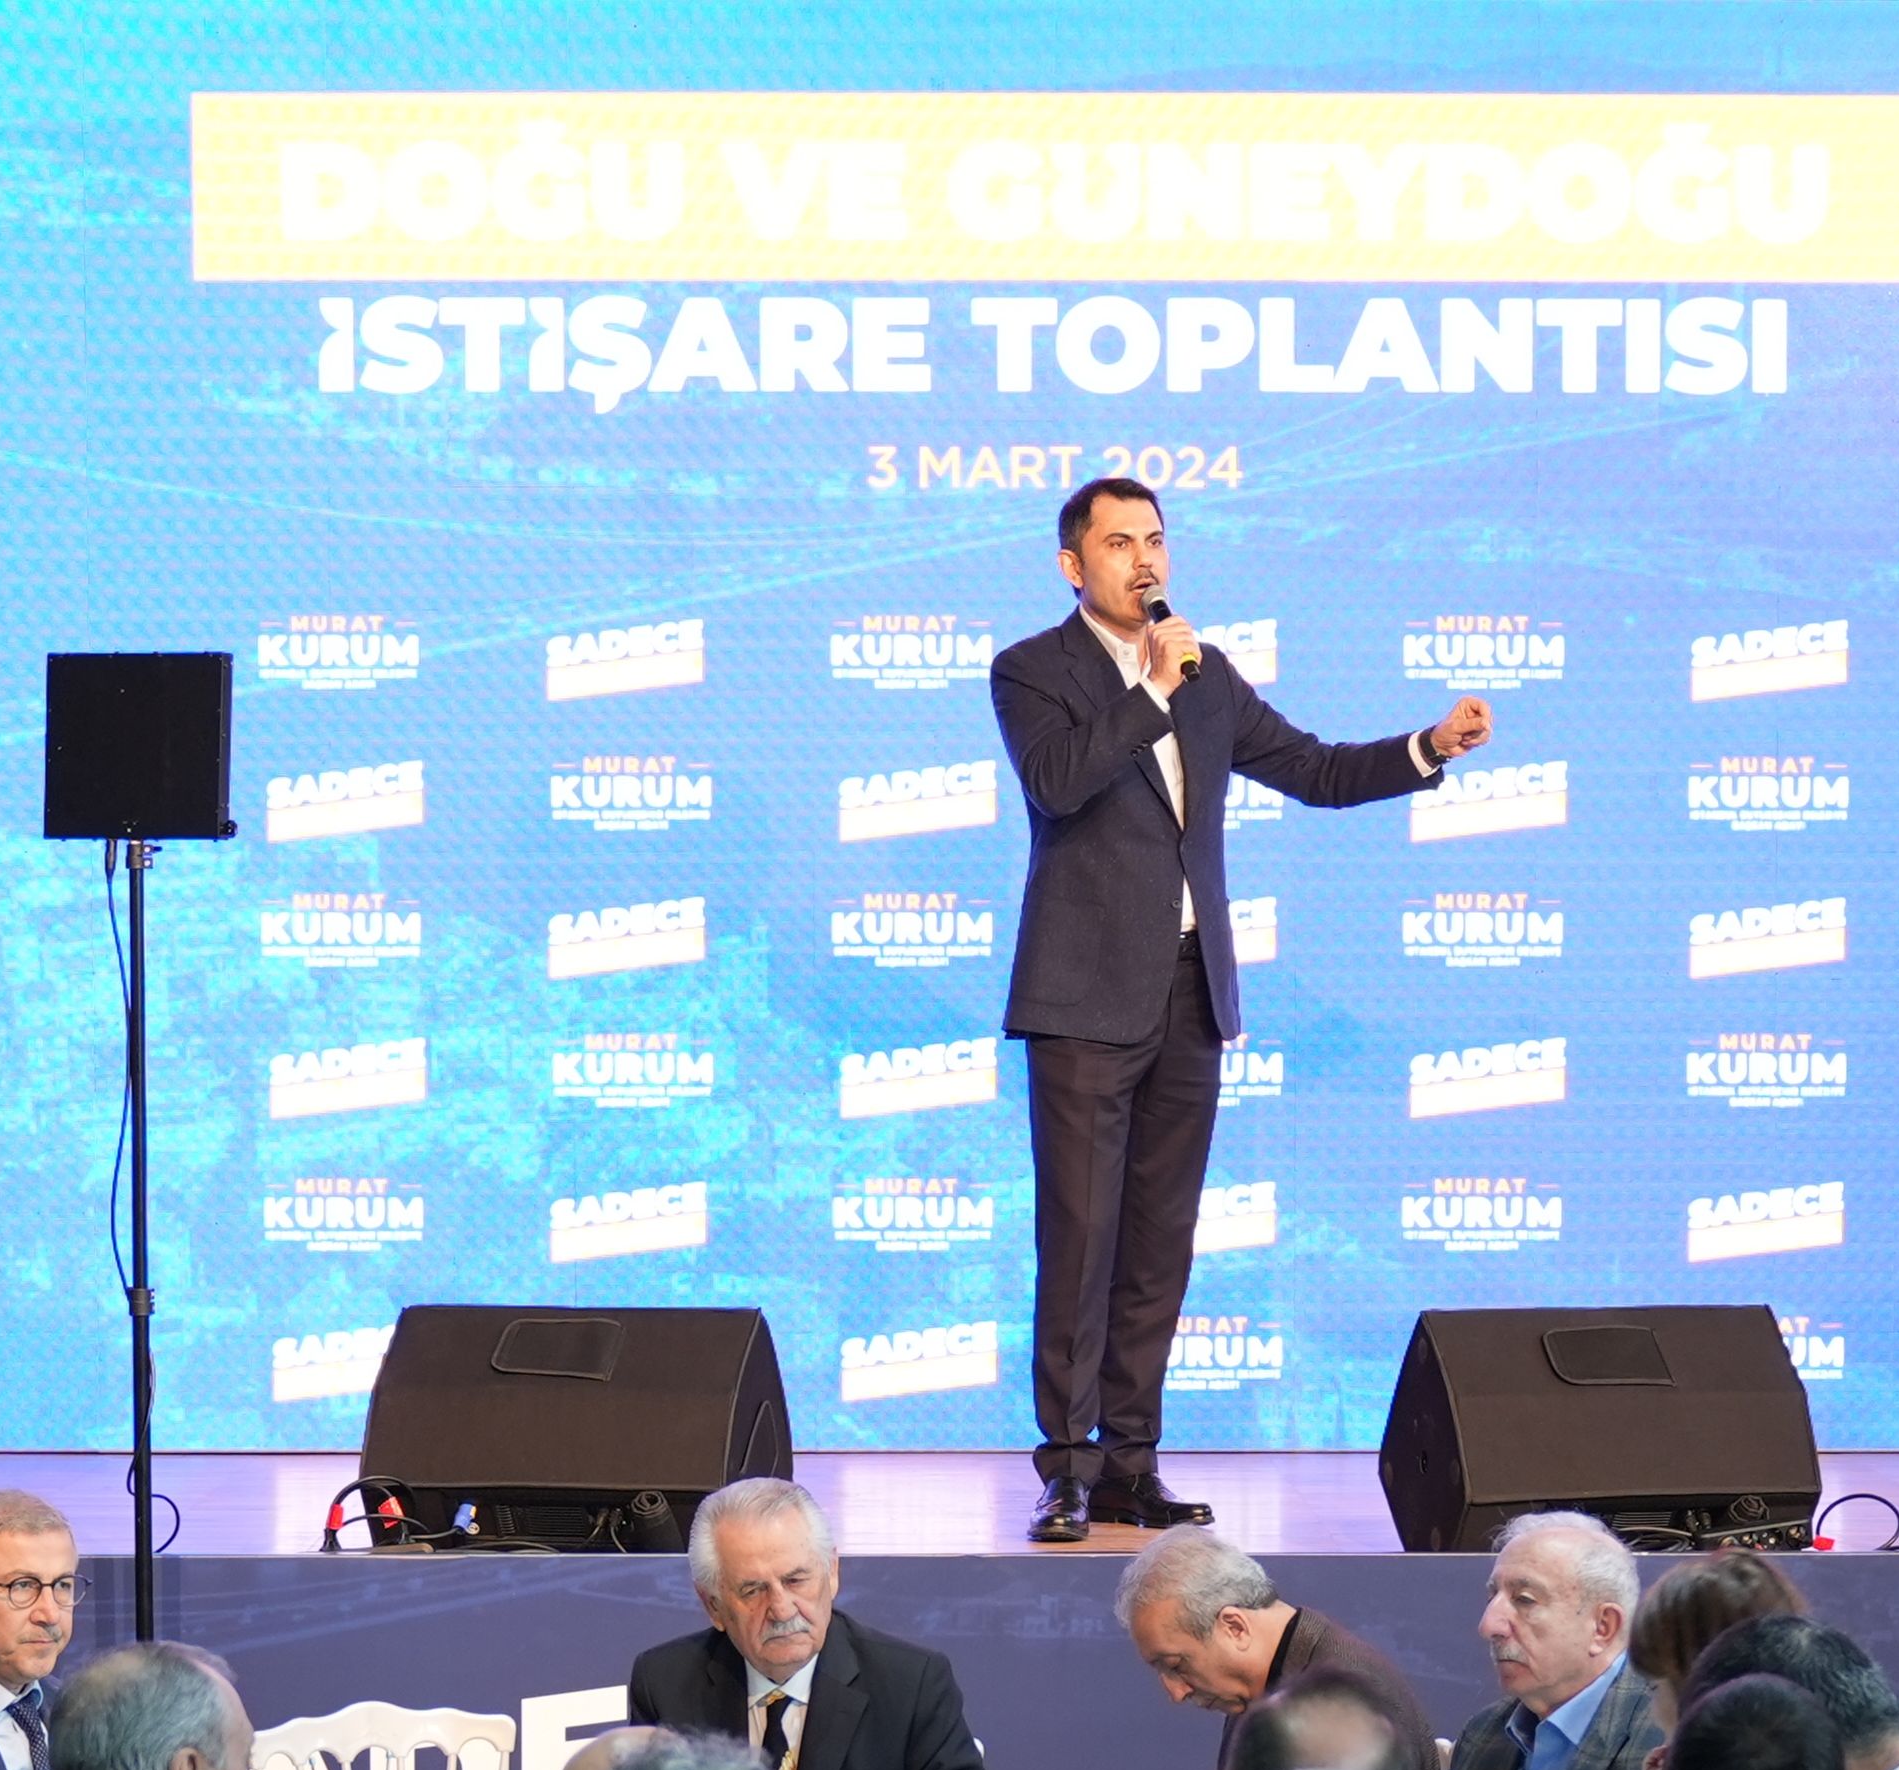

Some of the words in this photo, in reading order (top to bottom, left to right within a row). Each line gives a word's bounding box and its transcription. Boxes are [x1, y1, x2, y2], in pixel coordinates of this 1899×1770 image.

[277, 117, 683, 242] DOĞU
[718, 141, 907, 241] VE
[971, 295, 1789, 395] TOPLANTISI
[867, 445, 898, 489] 3
[918, 445, 1082, 489] MART
[1102, 445, 1244, 489] 2024
[291, 616, 383, 631] MURAT
[863, 616, 956, 631] MURAT
[1437, 616, 1528, 631] MURAT
[259, 634, 419, 666] KURUM
[547, 619, 704, 667] SADECE
[831, 634, 992, 666] KURUM
[1404, 634, 1564, 666] KURUM
[1692, 620, 1849, 667] SADECE
[584, 757, 675, 773] MURAT
[1722, 757, 1813, 773] MURAT
[266, 761, 423, 809] SADECE
[550, 776, 711, 808] KURUM
[839, 761, 996, 809] SADECE
[1689, 776, 1848, 808] KURUM
[293, 894, 384, 909] MURAT
[864, 894, 956, 909] MURAT
[1436, 894, 1527, 909] MURAT
[261, 912, 421, 944] KURUM
[548, 897, 705, 945] SADECE
[832, 912, 992, 944] KURUM
[1403, 912, 1562, 944] KURUM
[1690, 897, 1846, 945] SADECE
[585, 1034, 677, 1049] MURAT
[1720, 1034, 1811, 1049] MURAT
[269, 1038, 426, 1086] SADECE
[553, 1053, 713, 1084] KURUM
[840, 1037, 997, 1085] SADECE
[1410, 1037, 1566, 1085] SADECE
[1687, 1053, 1846, 1084] KURUM
[296, 1179, 387, 1193] MURAT
[866, 1179, 956, 1193] MURAT
[1435, 1179, 1526, 1193] MURAT
[264, 1197, 423, 1228] KURUM
[550, 1182, 706, 1230] SADECE
[833, 1197, 992, 1228] KURUM
[1402, 1197, 1561, 1228] KURUM
[1688, 1182, 1844, 1229] SADECE
[842, 1321, 997, 1368] SADECE
